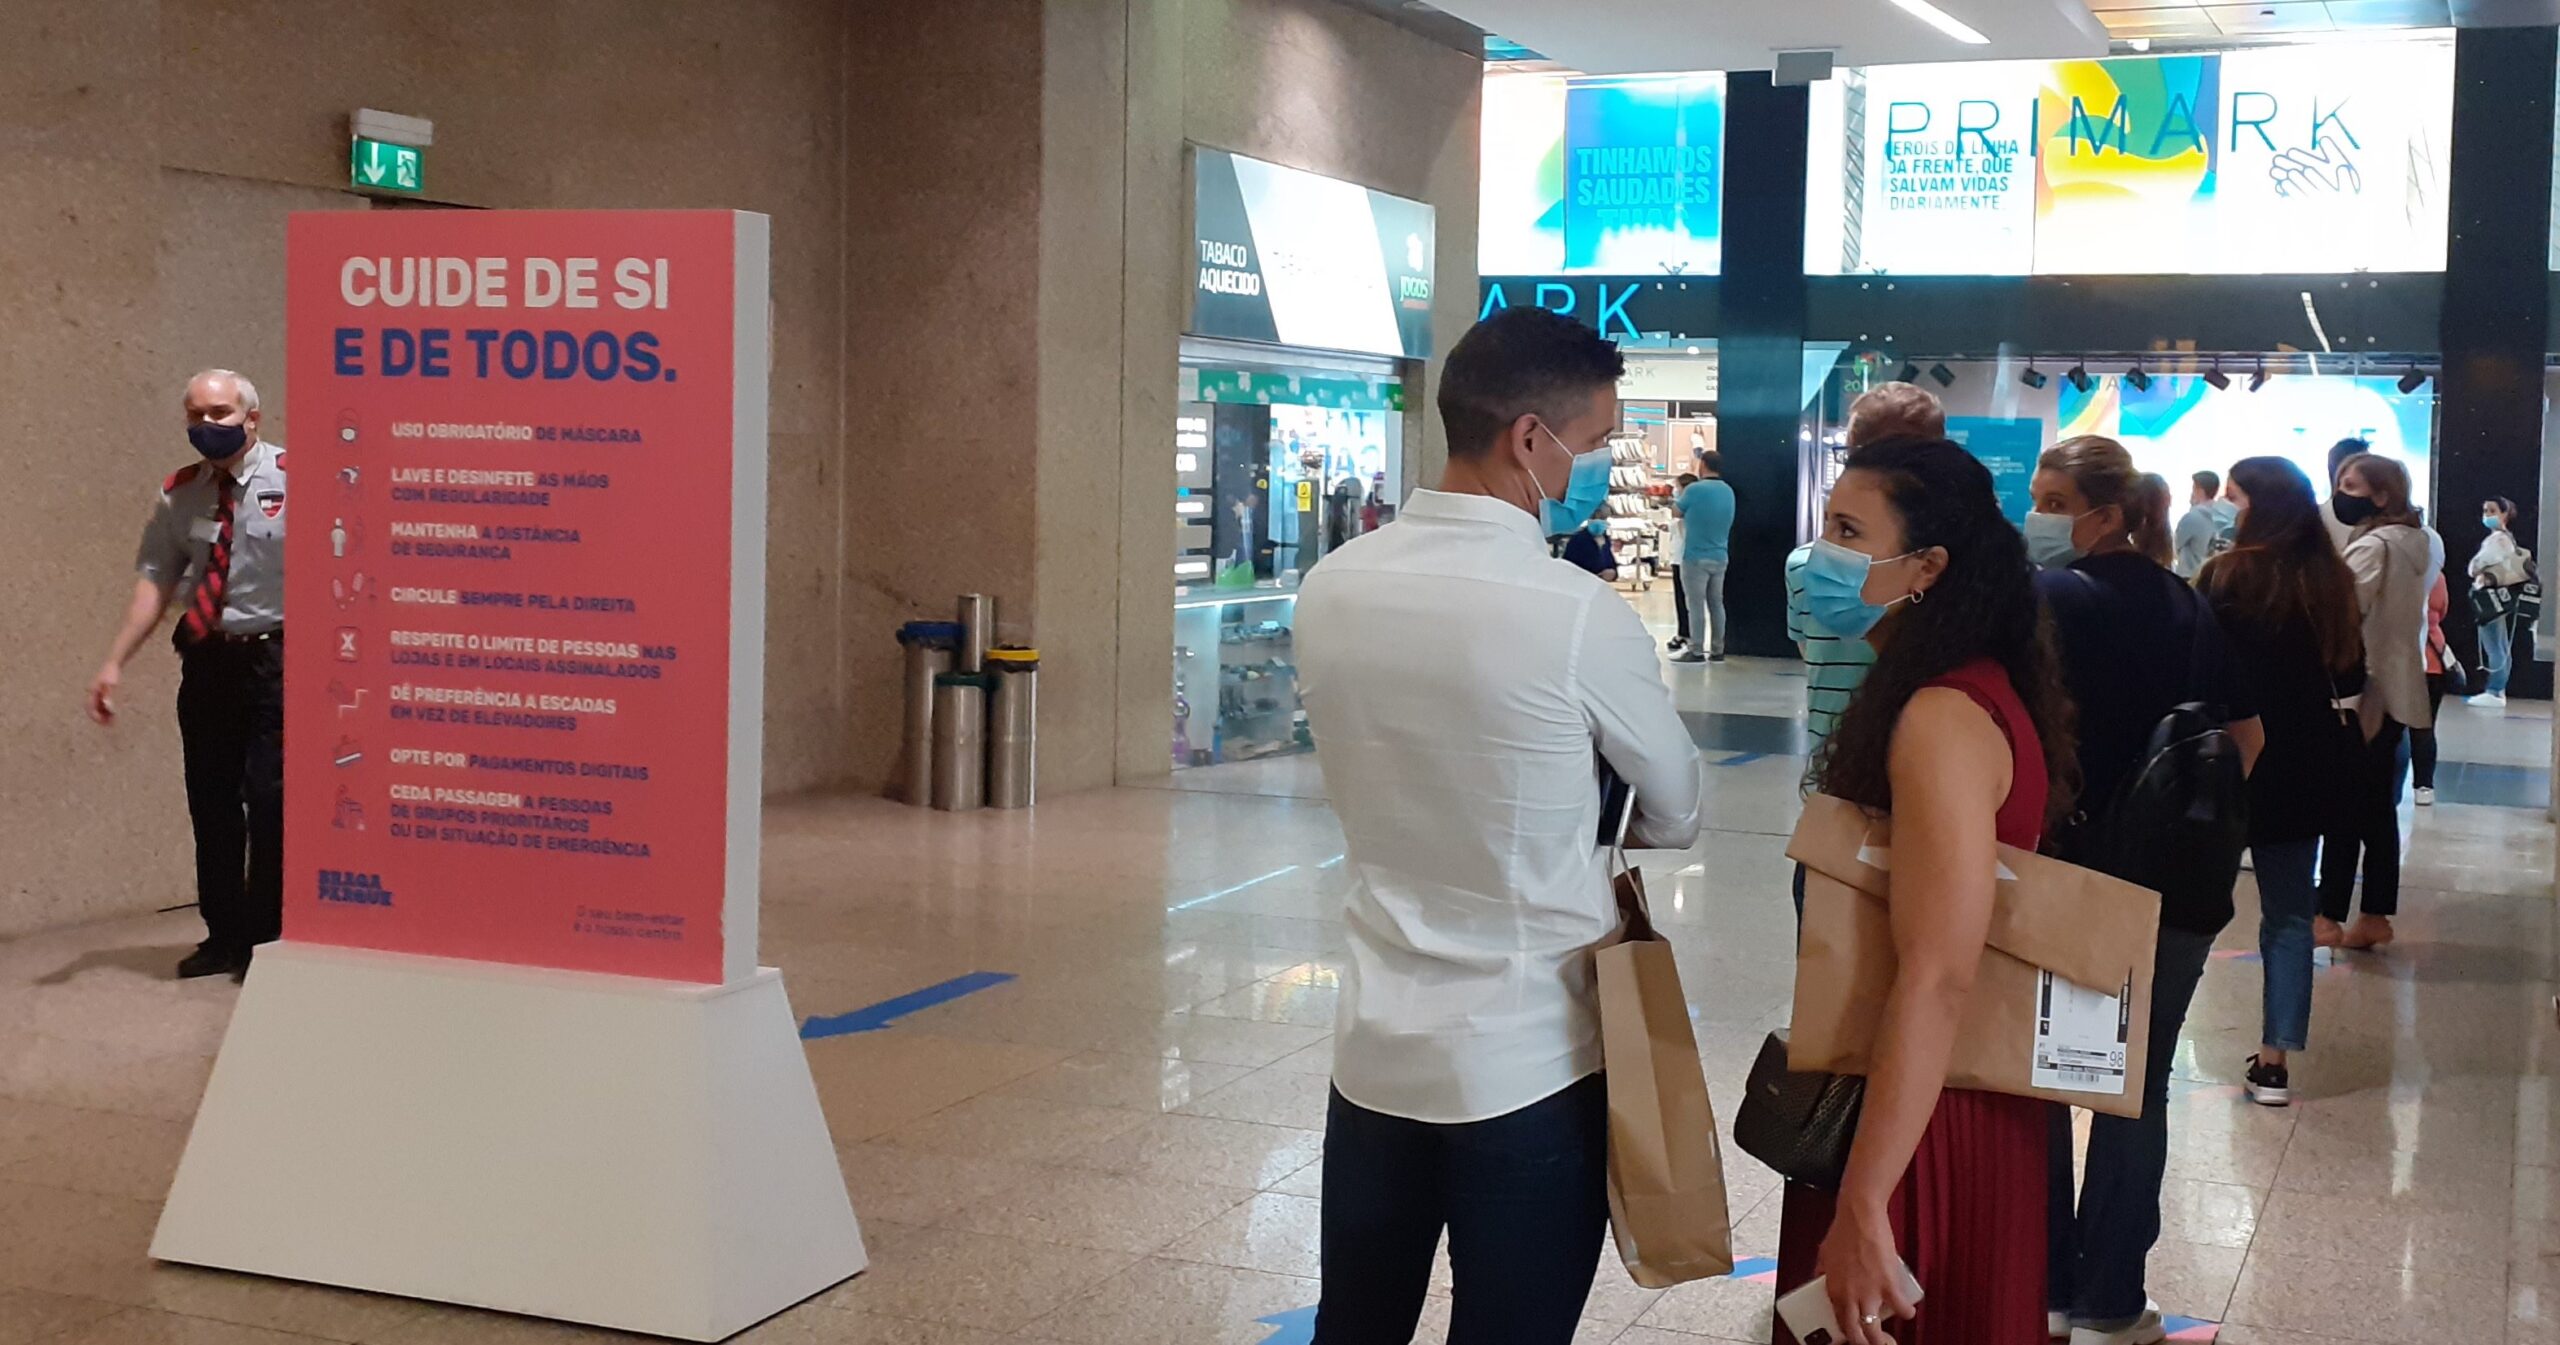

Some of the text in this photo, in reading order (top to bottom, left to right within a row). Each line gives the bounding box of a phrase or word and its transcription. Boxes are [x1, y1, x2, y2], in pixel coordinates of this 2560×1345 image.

[1887, 92, 2360, 161] PRIMARK
[1576, 145, 1712, 175] TINHAMOS
[1913, 158, 1979, 174] FRENTE,
[1982, 158, 2013, 175] QUE
[1578, 176, 1711, 206] SAUDADES
[1889, 176, 2008, 193] SALVAM VIDAS
[1200, 240, 1247, 268] TABACO
[340, 257, 669, 310] CUIDE DE SI
[1199, 268, 1260, 296] AQUECIDO
[334, 328, 677, 383] E DE TODOS.
[392, 422, 424, 437] USO
[427, 421, 533, 440] OBRIGATÓRIO
[537, 427, 556, 441] DE
[391, 468, 431, 483] LAVE
[434, 469, 445, 483] E
[448, 470, 535, 486] DESINFETE
[538, 473, 559, 487] AS
[392, 488, 550, 506] COM REGULARIDADE
[391, 523, 478, 539] MANTENHA
[482, 526, 492, 539] A
[392, 542, 412, 556] DE
[391, 587, 636, 612] CIRCULE SEMPRE PELA DIREITA
[390, 630, 677, 660] RESPEITE O LIMITE DE PESSOAS NAS
[391, 651, 661, 679] LOJAS E EM LOCAIS ASSINALADOS
[391, 683, 616, 714] DÊ PREFERÊNCIA A ESCADAS
[391, 705, 577, 731] EM VEZ DE ELEVADORES
[390, 749, 648, 780] OPTE POR PAGAMENTOS DIGITAIS
[390, 785, 613, 814] CEDA PASSAGEM A PESSOAS
[391, 804, 409, 818] DE
[415, 806, 477, 823] GRUPOS
[391, 823, 411, 837] OU
[416, 825, 436, 839] EM
[522, 834, 542, 848] DE
[2109, 1051, 2124, 1068] 98
